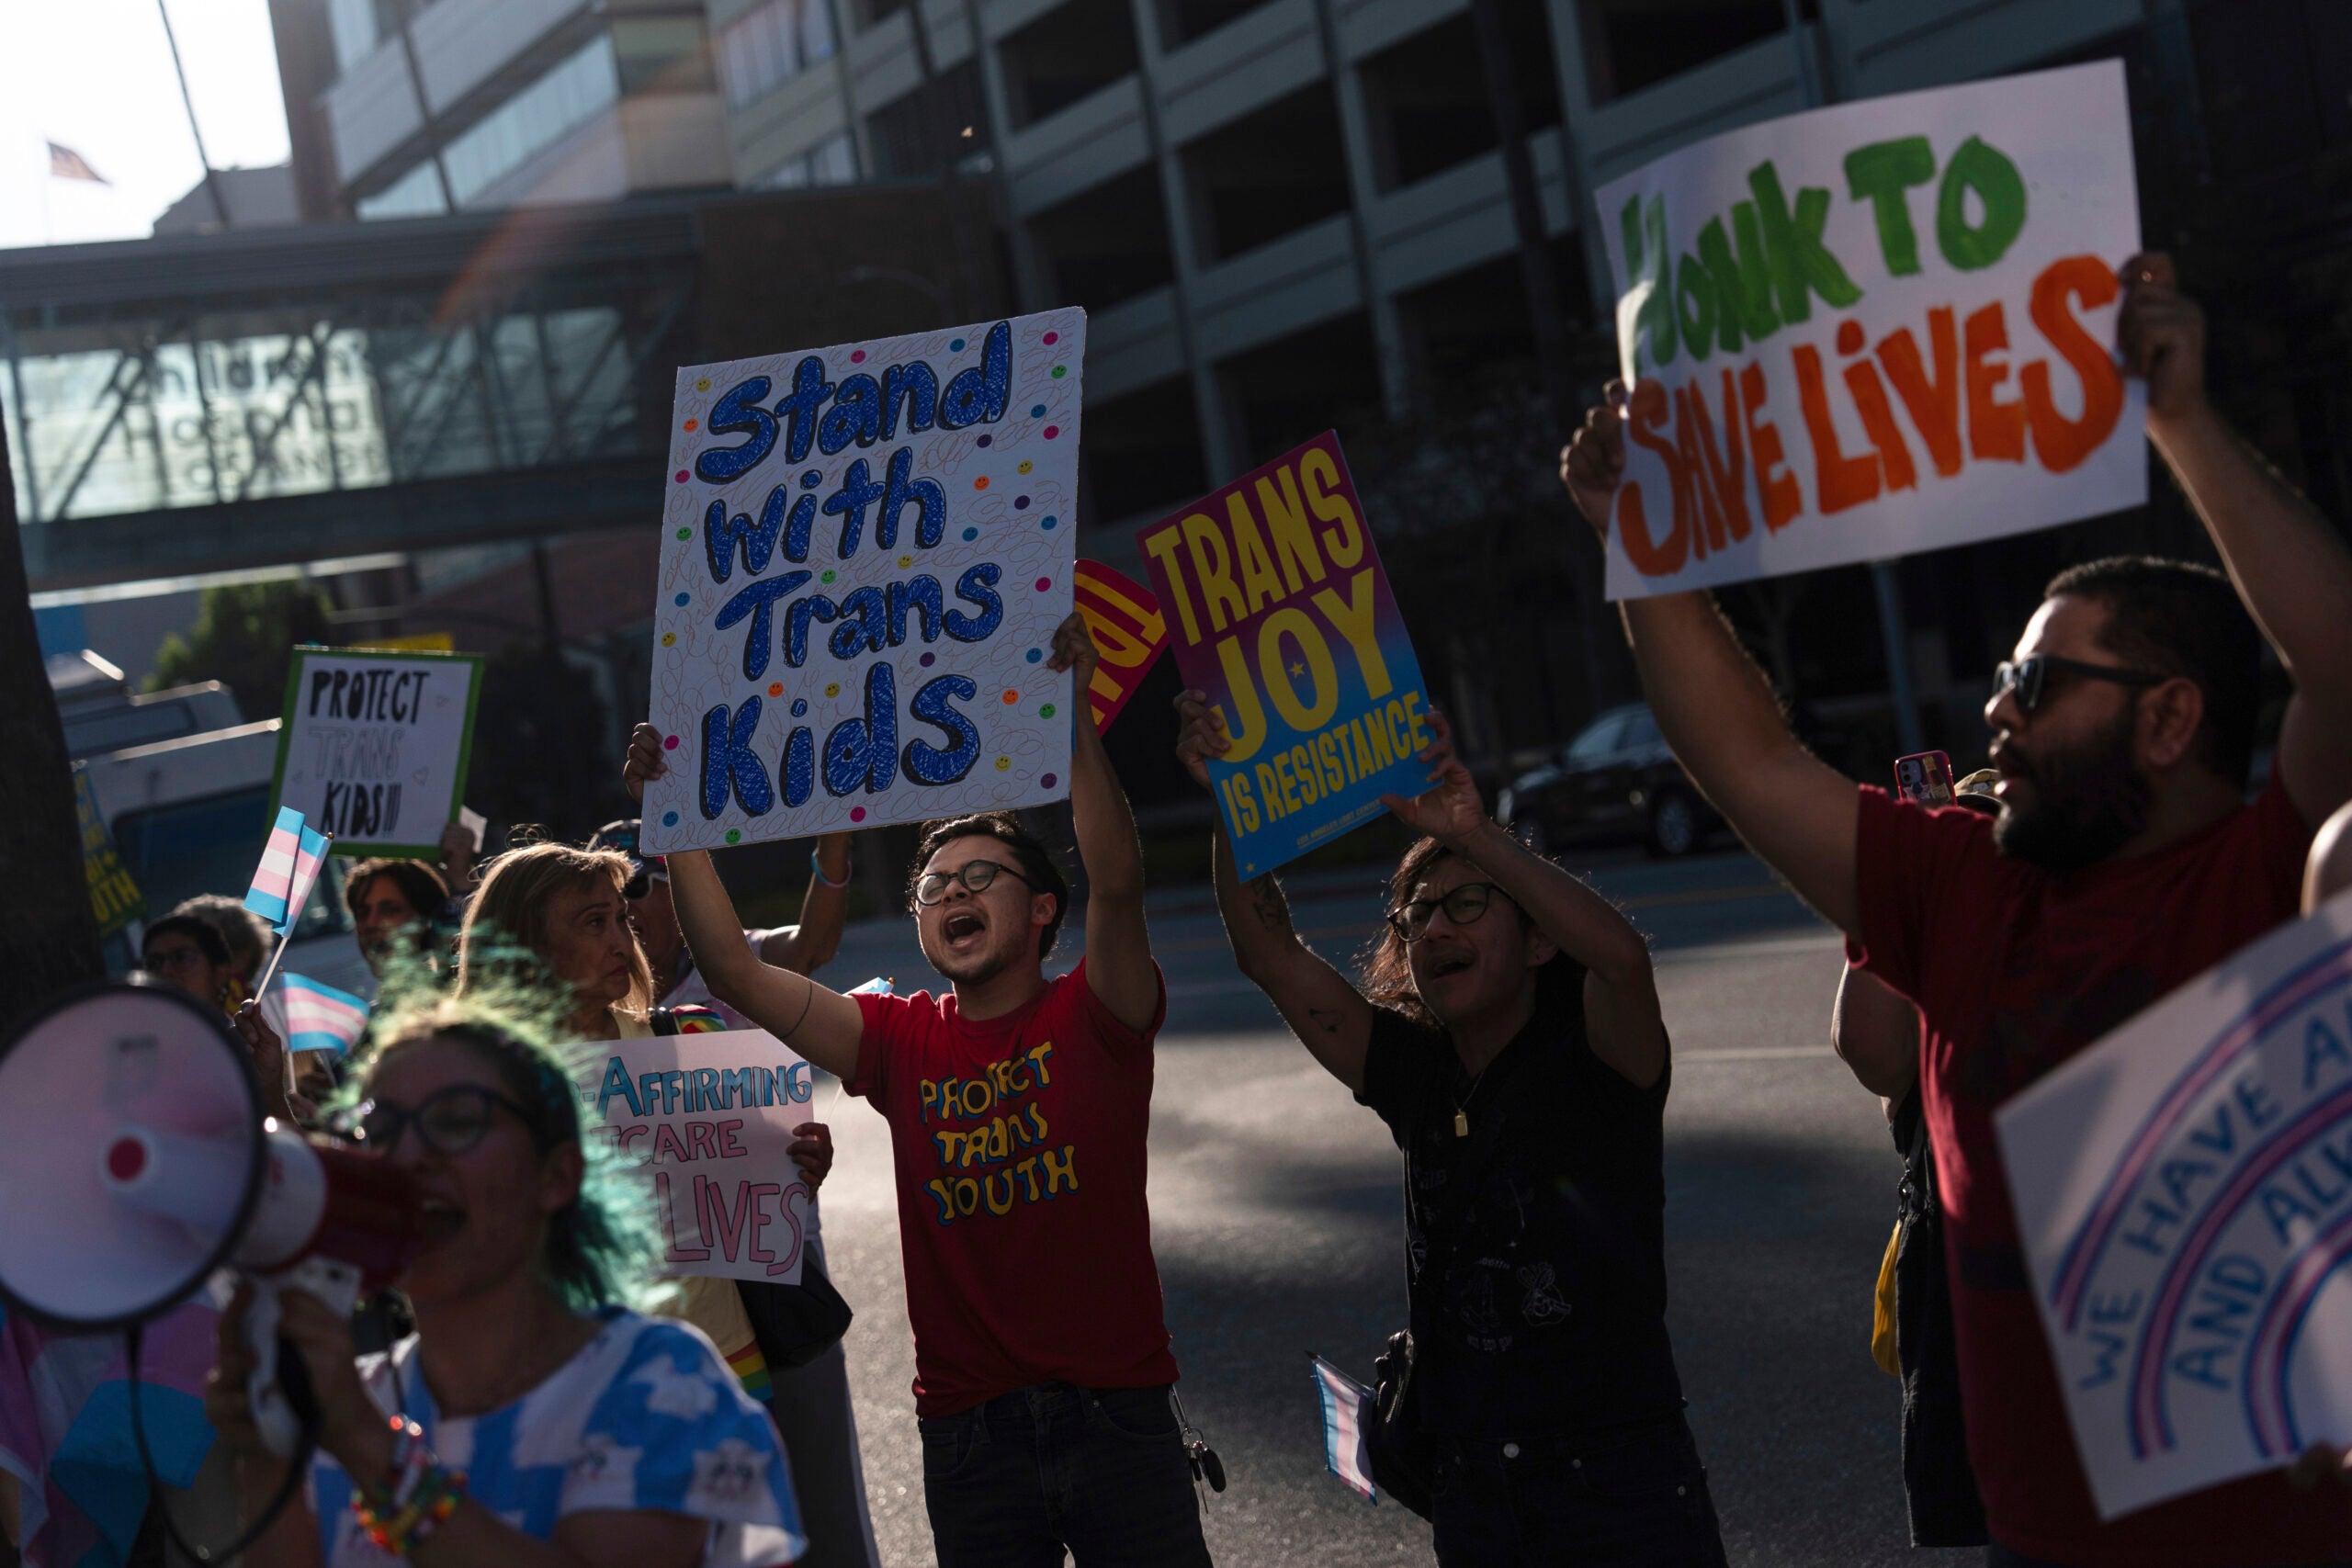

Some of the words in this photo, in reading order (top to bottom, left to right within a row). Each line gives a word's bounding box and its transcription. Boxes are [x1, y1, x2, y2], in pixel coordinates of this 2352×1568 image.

[1843, 135, 2027, 278] TO
[695, 320, 1013, 485] Stand
[1617, 362, 1804, 577] SAVE
[1145, 447, 1364, 647] TRANS
[715, 561, 1004, 681] Trans
[1211, 566, 1393, 763] JOY
[308, 726, 405, 781] TRANS
[310, 669, 431, 725] PROTECT
[1220, 771, 1261, 839] IS
[1256, 690, 1430, 823] RESISTANCE
[923, 1145, 1080, 1226] YOUTH
[933, 1101, 1049, 1169] TRANS
[656, 1171, 809, 1278] LIVES
[2080, 1289, 2144, 1392] WE
[2122, 1071, 2283, 1257] HAVE
[2169, 1251, 2266, 1392] AND
